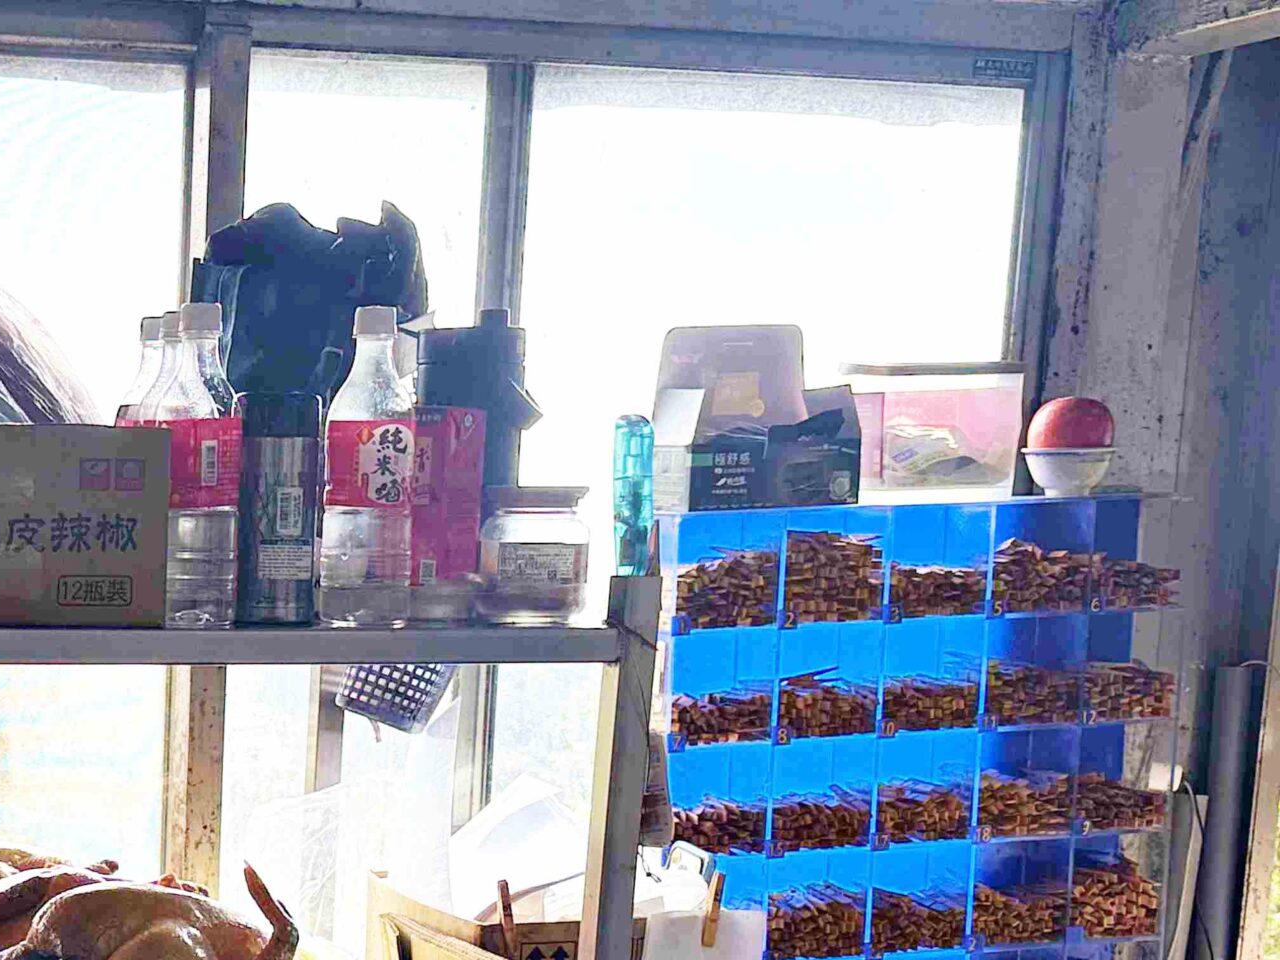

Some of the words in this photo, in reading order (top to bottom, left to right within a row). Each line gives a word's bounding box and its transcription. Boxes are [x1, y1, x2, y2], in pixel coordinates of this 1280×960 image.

[372, 427, 408, 503] 純米酒
[61, 580, 128, 603] 12瓶裝
